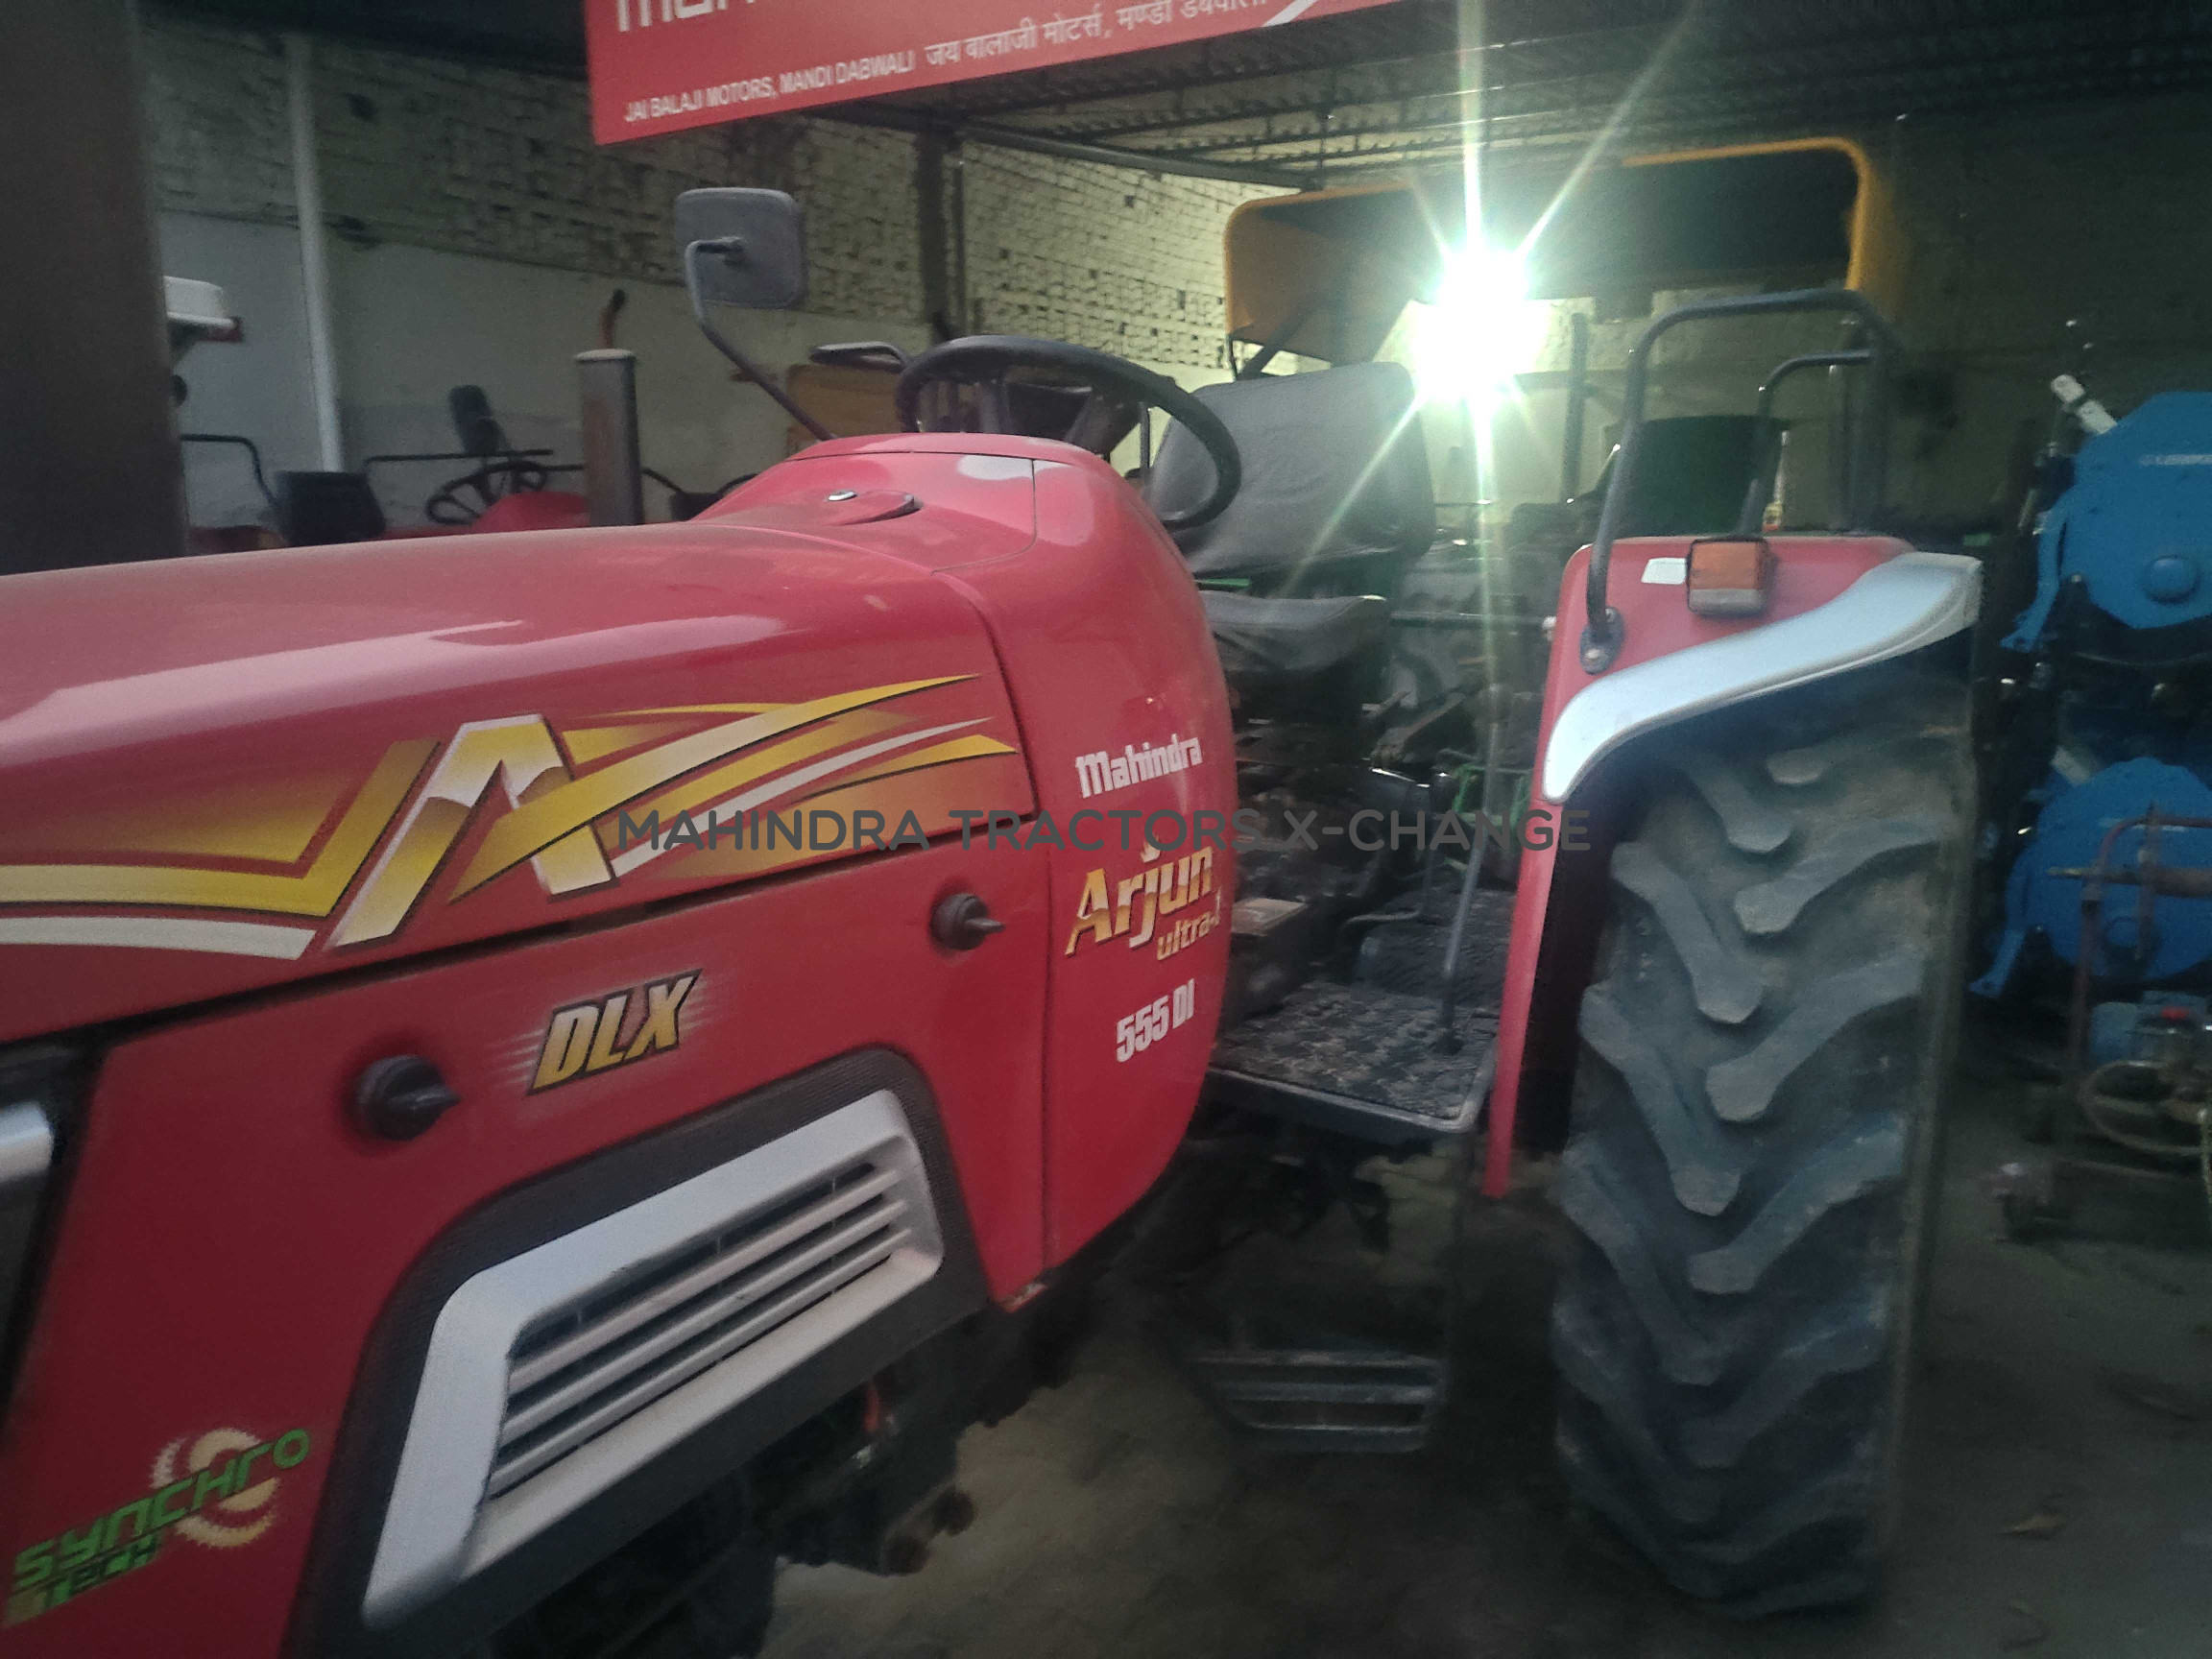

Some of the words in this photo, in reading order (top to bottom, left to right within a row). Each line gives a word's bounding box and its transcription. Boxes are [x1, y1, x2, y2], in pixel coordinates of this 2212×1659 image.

[624, 100, 648, 122] JAI
[650, 89, 702, 118] BALAJI
[779, 64, 832, 94] MANDI
[835, 49, 916, 84] DABWALI
[924, 42, 960, 66] जय
[1065, 833, 1215, 957] Arjun
[528, 969, 702, 1095] DLX
[1117, 995, 1170, 1063] 555
[1172, 977, 1196, 1030] DI
